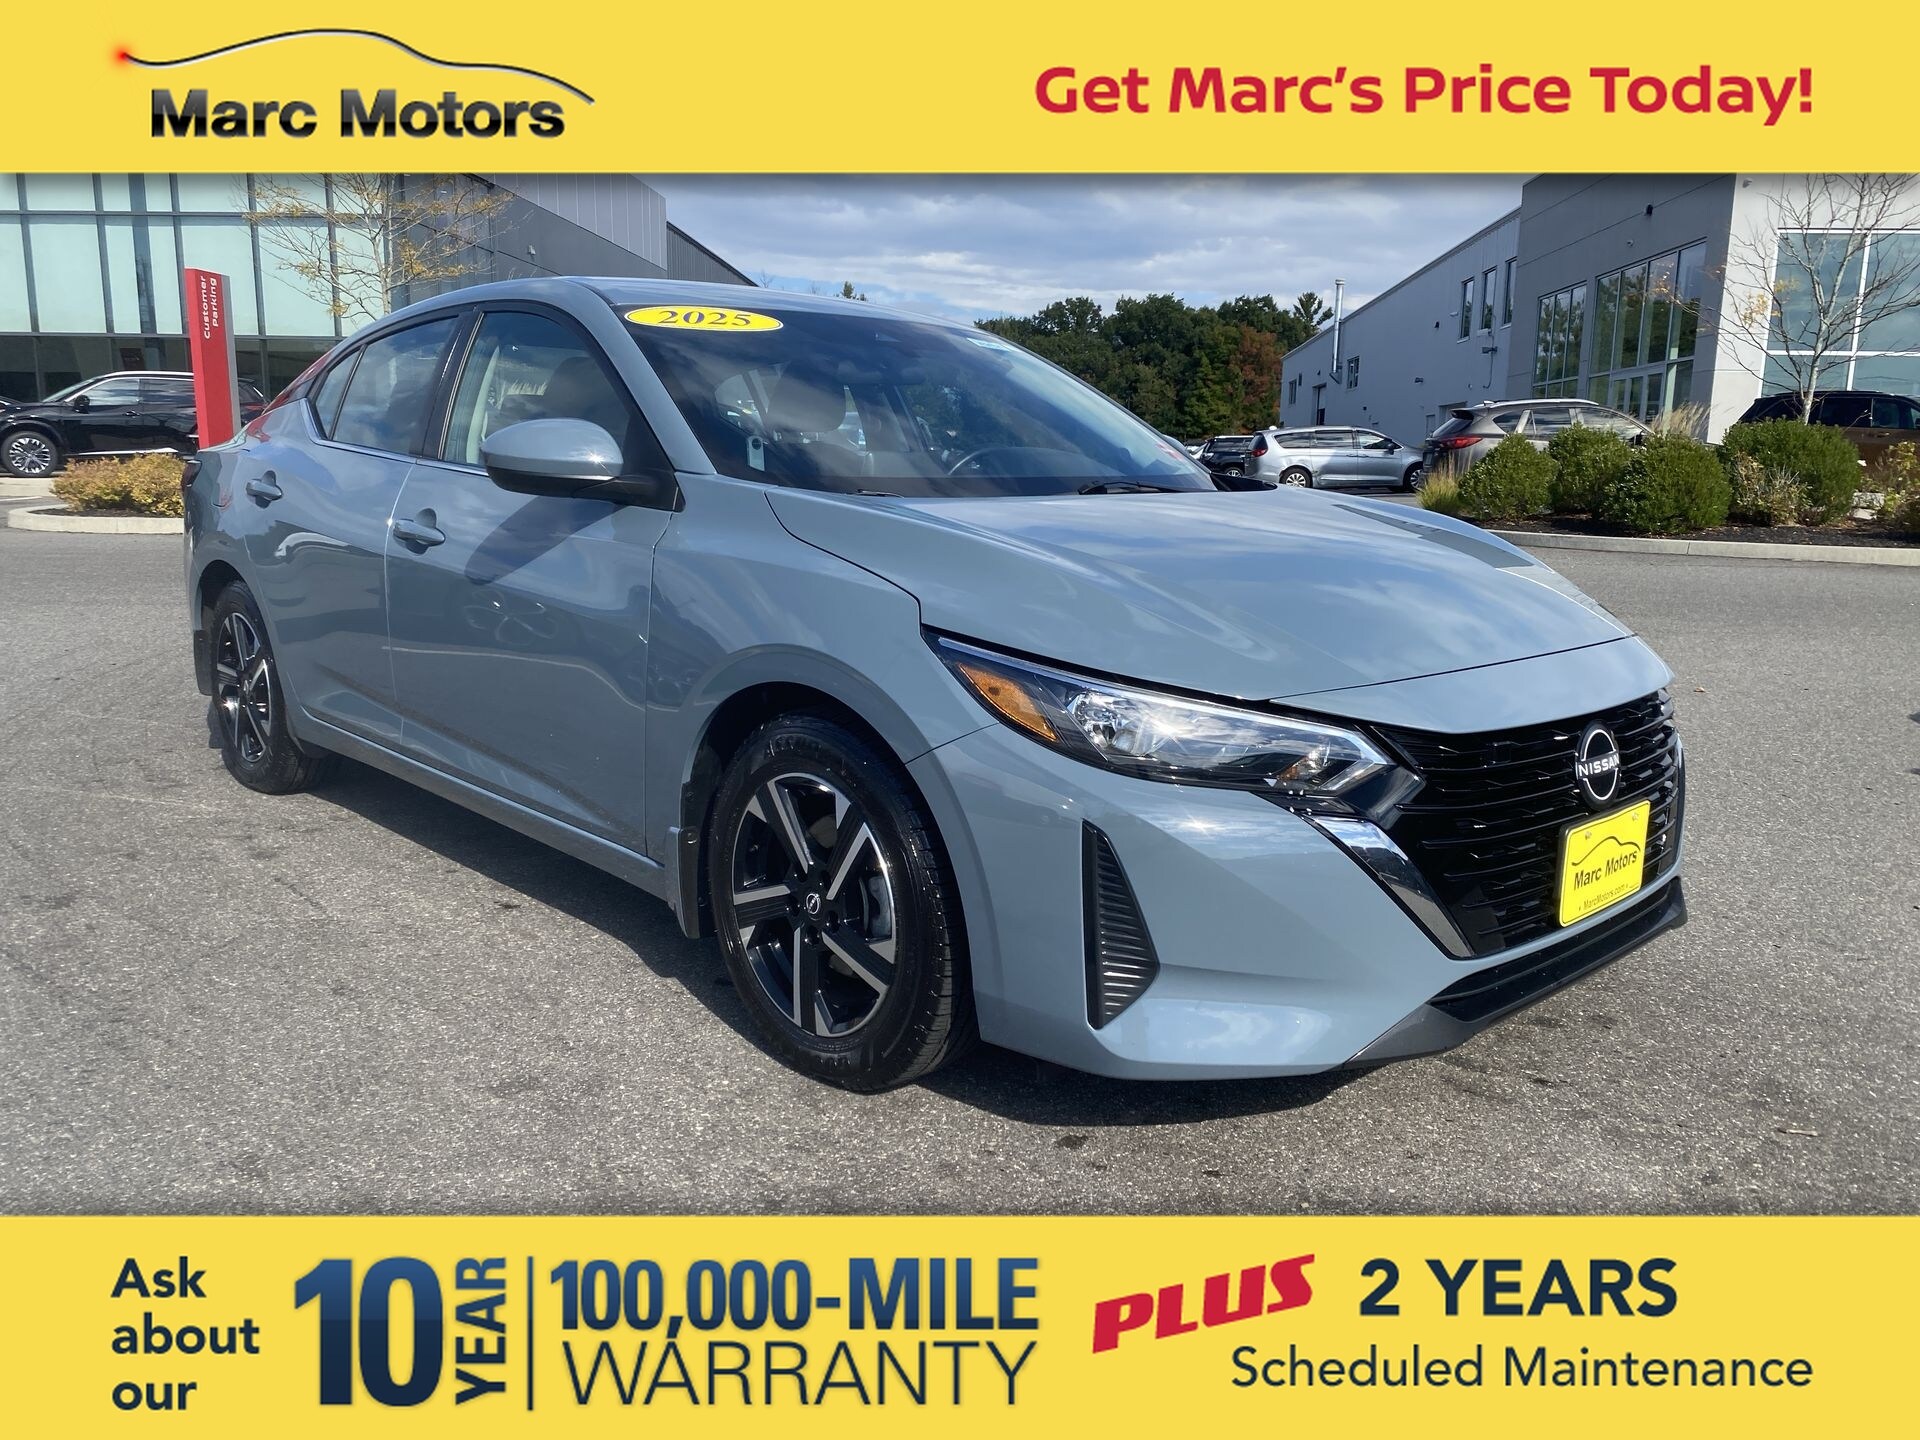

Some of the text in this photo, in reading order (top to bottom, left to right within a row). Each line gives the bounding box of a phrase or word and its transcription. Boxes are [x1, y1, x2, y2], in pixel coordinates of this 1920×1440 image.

[200, 275, 211, 339] Customer
[209, 277, 219, 327] Parking
[658, 310, 751, 327] 2025
[1578, 753, 1619, 776] NISSAN
[1574, 850, 1637, 890] Marc Motors
